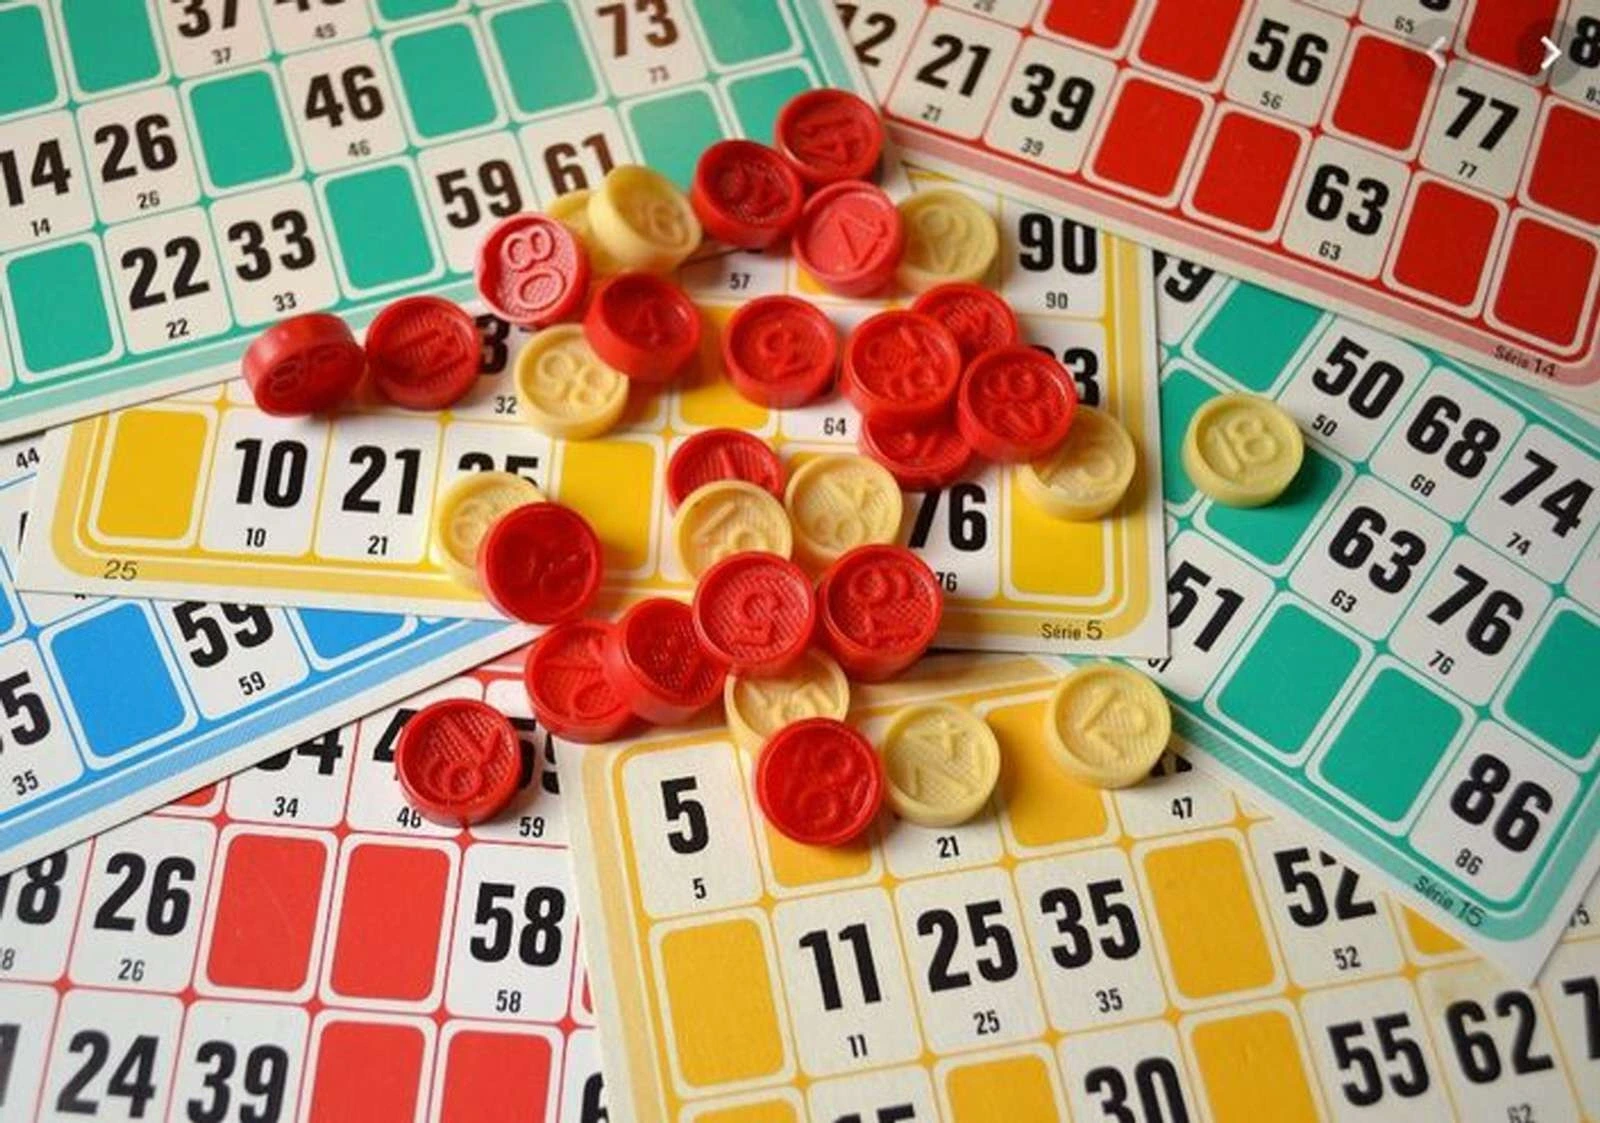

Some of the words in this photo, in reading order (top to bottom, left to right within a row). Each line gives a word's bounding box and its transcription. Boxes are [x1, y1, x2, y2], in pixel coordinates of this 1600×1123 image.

[596, 0, 679, 59] 73
[1394, 15, 1415, 35] 65
[915, 33, 992, 98] 21
[1247, 17, 1329, 87] 56
[304, 65, 385, 128] 46
[1010, 63, 1096, 132] 39
[920, 103, 942, 123] 21
[1445, 86, 1520, 152] 77
[94, 113, 178, 183] 26
[347, 139, 371, 158] 46
[1020, 136, 1045, 157] 39
[0, 138, 72, 207] 14
[544, 133, 615, 195] 61
[1458, 160, 1478, 179] 77
[137, 190, 161, 210] 26
[436, 159, 523, 229] 59
[1305, 163, 1390, 236] 63
[31, 217, 51, 237] 14
[227, 209, 316, 282] 33
[1018, 212, 1097, 275] 90
[1318, 240, 1342, 262] 63
[120, 236, 210, 311] 22
[729, 272, 751, 290] 57
[273, 291, 297, 313] 33
[1045, 291, 1069, 310] 90
[165, 317, 190, 340] 22
[1311, 336, 1405, 420] 50
[494, 394, 518, 415] 32
[823, 416, 847, 436] 64
[1311, 415, 1338, 438] 50
[1406, 395, 1501, 479] 68
[15, 447, 41, 469] 44
[235, 438, 308, 509] 10
[341, 445, 421, 515] 21
[1409, 473, 1437, 498] 68
[1499, 449, 1595, 538] 74
[908, 484, 987, 552] 76
[246, 527, 267, 548] 10
[367, 535, 388, 556] 21
[1328, 506, 1427, 595] 63
[1506, 532, 1532, 557] 74
[103, 559, 138, 582] 25
[1165, 558, 1245, 653] 51
[1330, 589, 1358, 614] 63
[1426, 564, 1524, 656] 76
[172, 599, 274, 668] 59
[1086, 619, 1103, 641] 5
[1428, 649, 1455, 676] 76
[238, 671, 266, 696] 59
[0, 671, 51, 746] 5
[11, 769, 39, 797] 35
[273, 795, 299, 818] 34
[660, 776, 709, 855] 5
[1171, 796, 1193, 820] 47
[1450, 753, 1554, 853] 86
[518, 816, 545, 839] 59
[936, 835, 960, 859] 21
[1455, 847, 1484, 876] 86
[93, 852, 196, 937] 26
[692, 877, 707, 900] 5
[1273, 847, 1377, 928] 52
[469, 881, 566, 968] 58
[1039, 878, 1141, 970] 35
[1457, 901, 1487, 928] 15
[916, 899, 1019, 993] 25
[1333, 945, 1362, 971] 52
[117, 958, 146, 983] 26
[798, 923, 882, 1011] 11
[495, 989, 522, 1014] 58
[1095, 987, 1123, 1014] 35
[973, 1009, 1001, 1036] 25
[847, 1033, 868, 1059] 11
[1445, 990, 1555, 1085] 62
[1327, 1012, 1430, 1107] 55
[55, 1030, 159, 1119] 24
[186, 1040, 289, 1123] 39
[1084, 1057, 1190, 1123] 30
